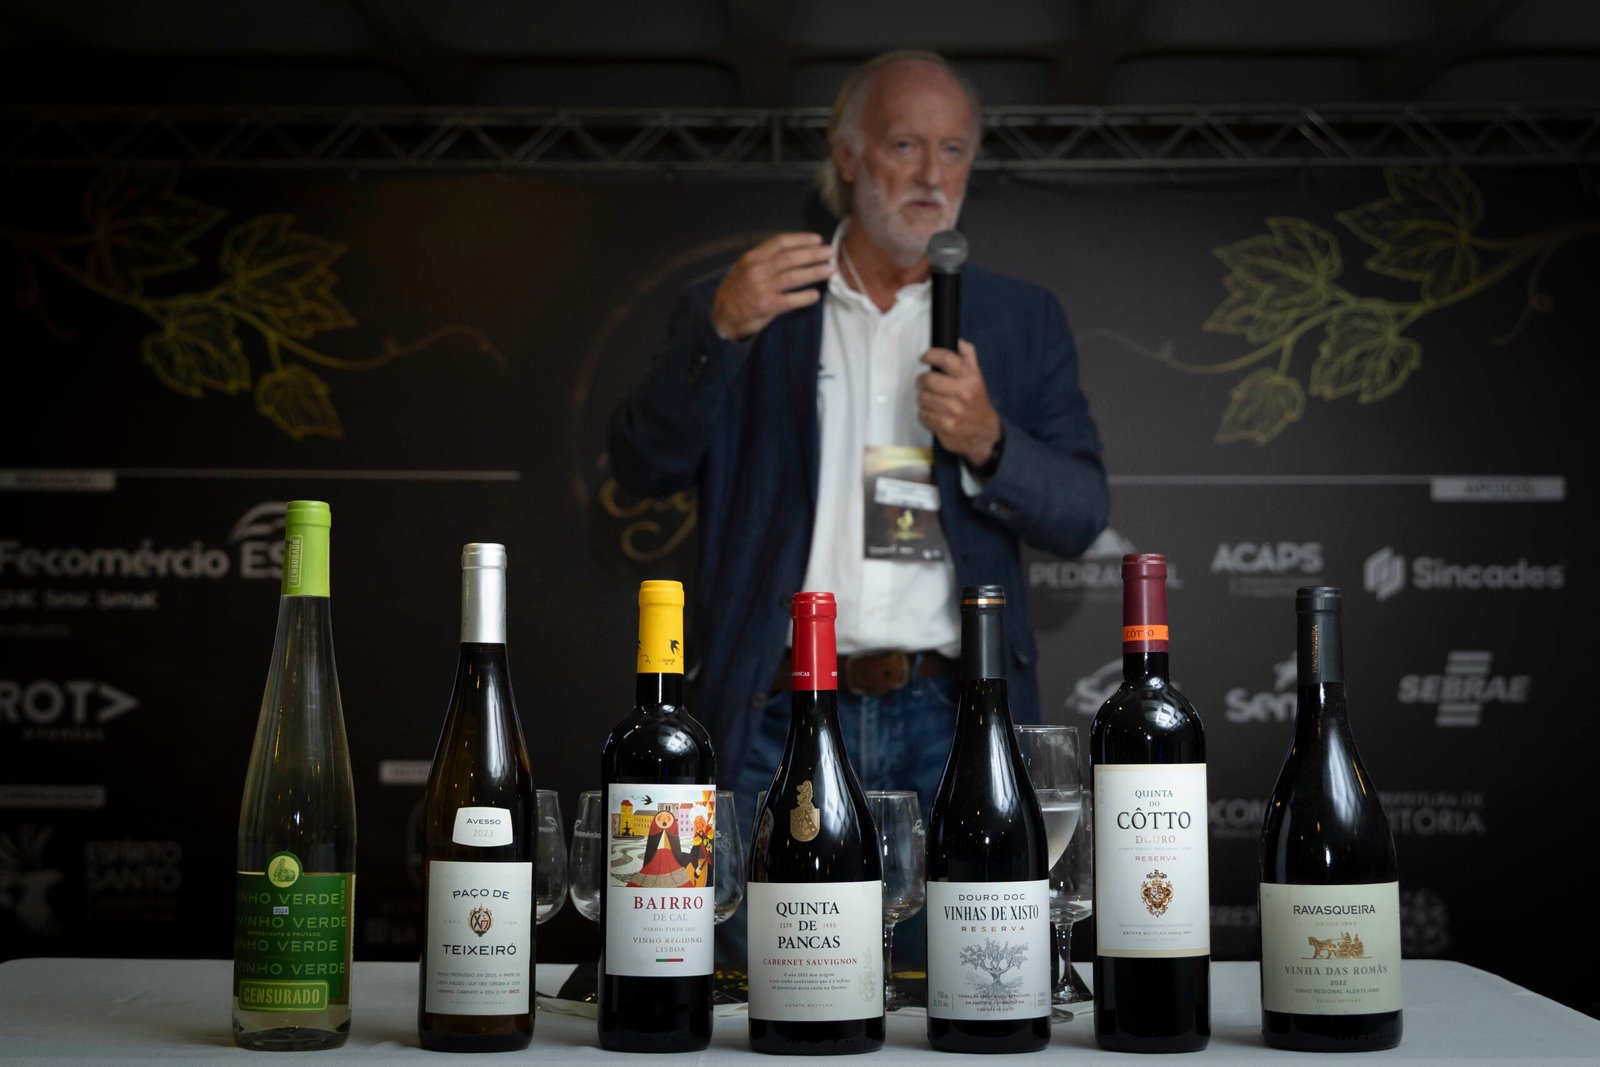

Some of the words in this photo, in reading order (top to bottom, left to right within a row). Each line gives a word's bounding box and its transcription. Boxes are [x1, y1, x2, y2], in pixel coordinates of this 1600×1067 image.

[0, 538, 231, 579] Fecomércio
[290, 539, 300, 583] CENSURADO
[1211, 541, 1324, 574] ACAPS
[1411, 556, 1566, 590] Sincades
[1397, 674, 1532, 704] SEBRAE
[1135, 790, 1174, 798] QUINTA
[1117, 807, 1191, 830] CÔTTO
[472, 829, 494, 837] 2023
[1136, 836, 1176, 844] DOURO
[279, 893, 340, 905] VERDE
[453, 888, 490, 899] PAÇO
[493, 890, 510, 899] DE
[633, 896, 704, 910] BAIRRO
[776, 902, 840, 917] QUINTA
[944, 905, 987, 920] VINHAS
[991, 906, 1007, 920] DE
[1011, 904, 1039, 920] XISTO
[1293, 904, 1376, 915] RAVASQUEIRA
[292, 916, 346, 928] VERDE
[798, 920, 817, 931] DE
[277, 940, 338, 952] VERDE
[777, 935, 841, 949] PANCAS
[442, 943, 517, 955] TEIXEIRÓ
[291, 963, 344, 975] VERDE
[1284, 966, 1320, 976] VINHA
[1326, 966, 1348, 976] DAS
[1353, 964, 1387, 975] ROMÃS
[244, 987, 320, 1004] CENSURADO
